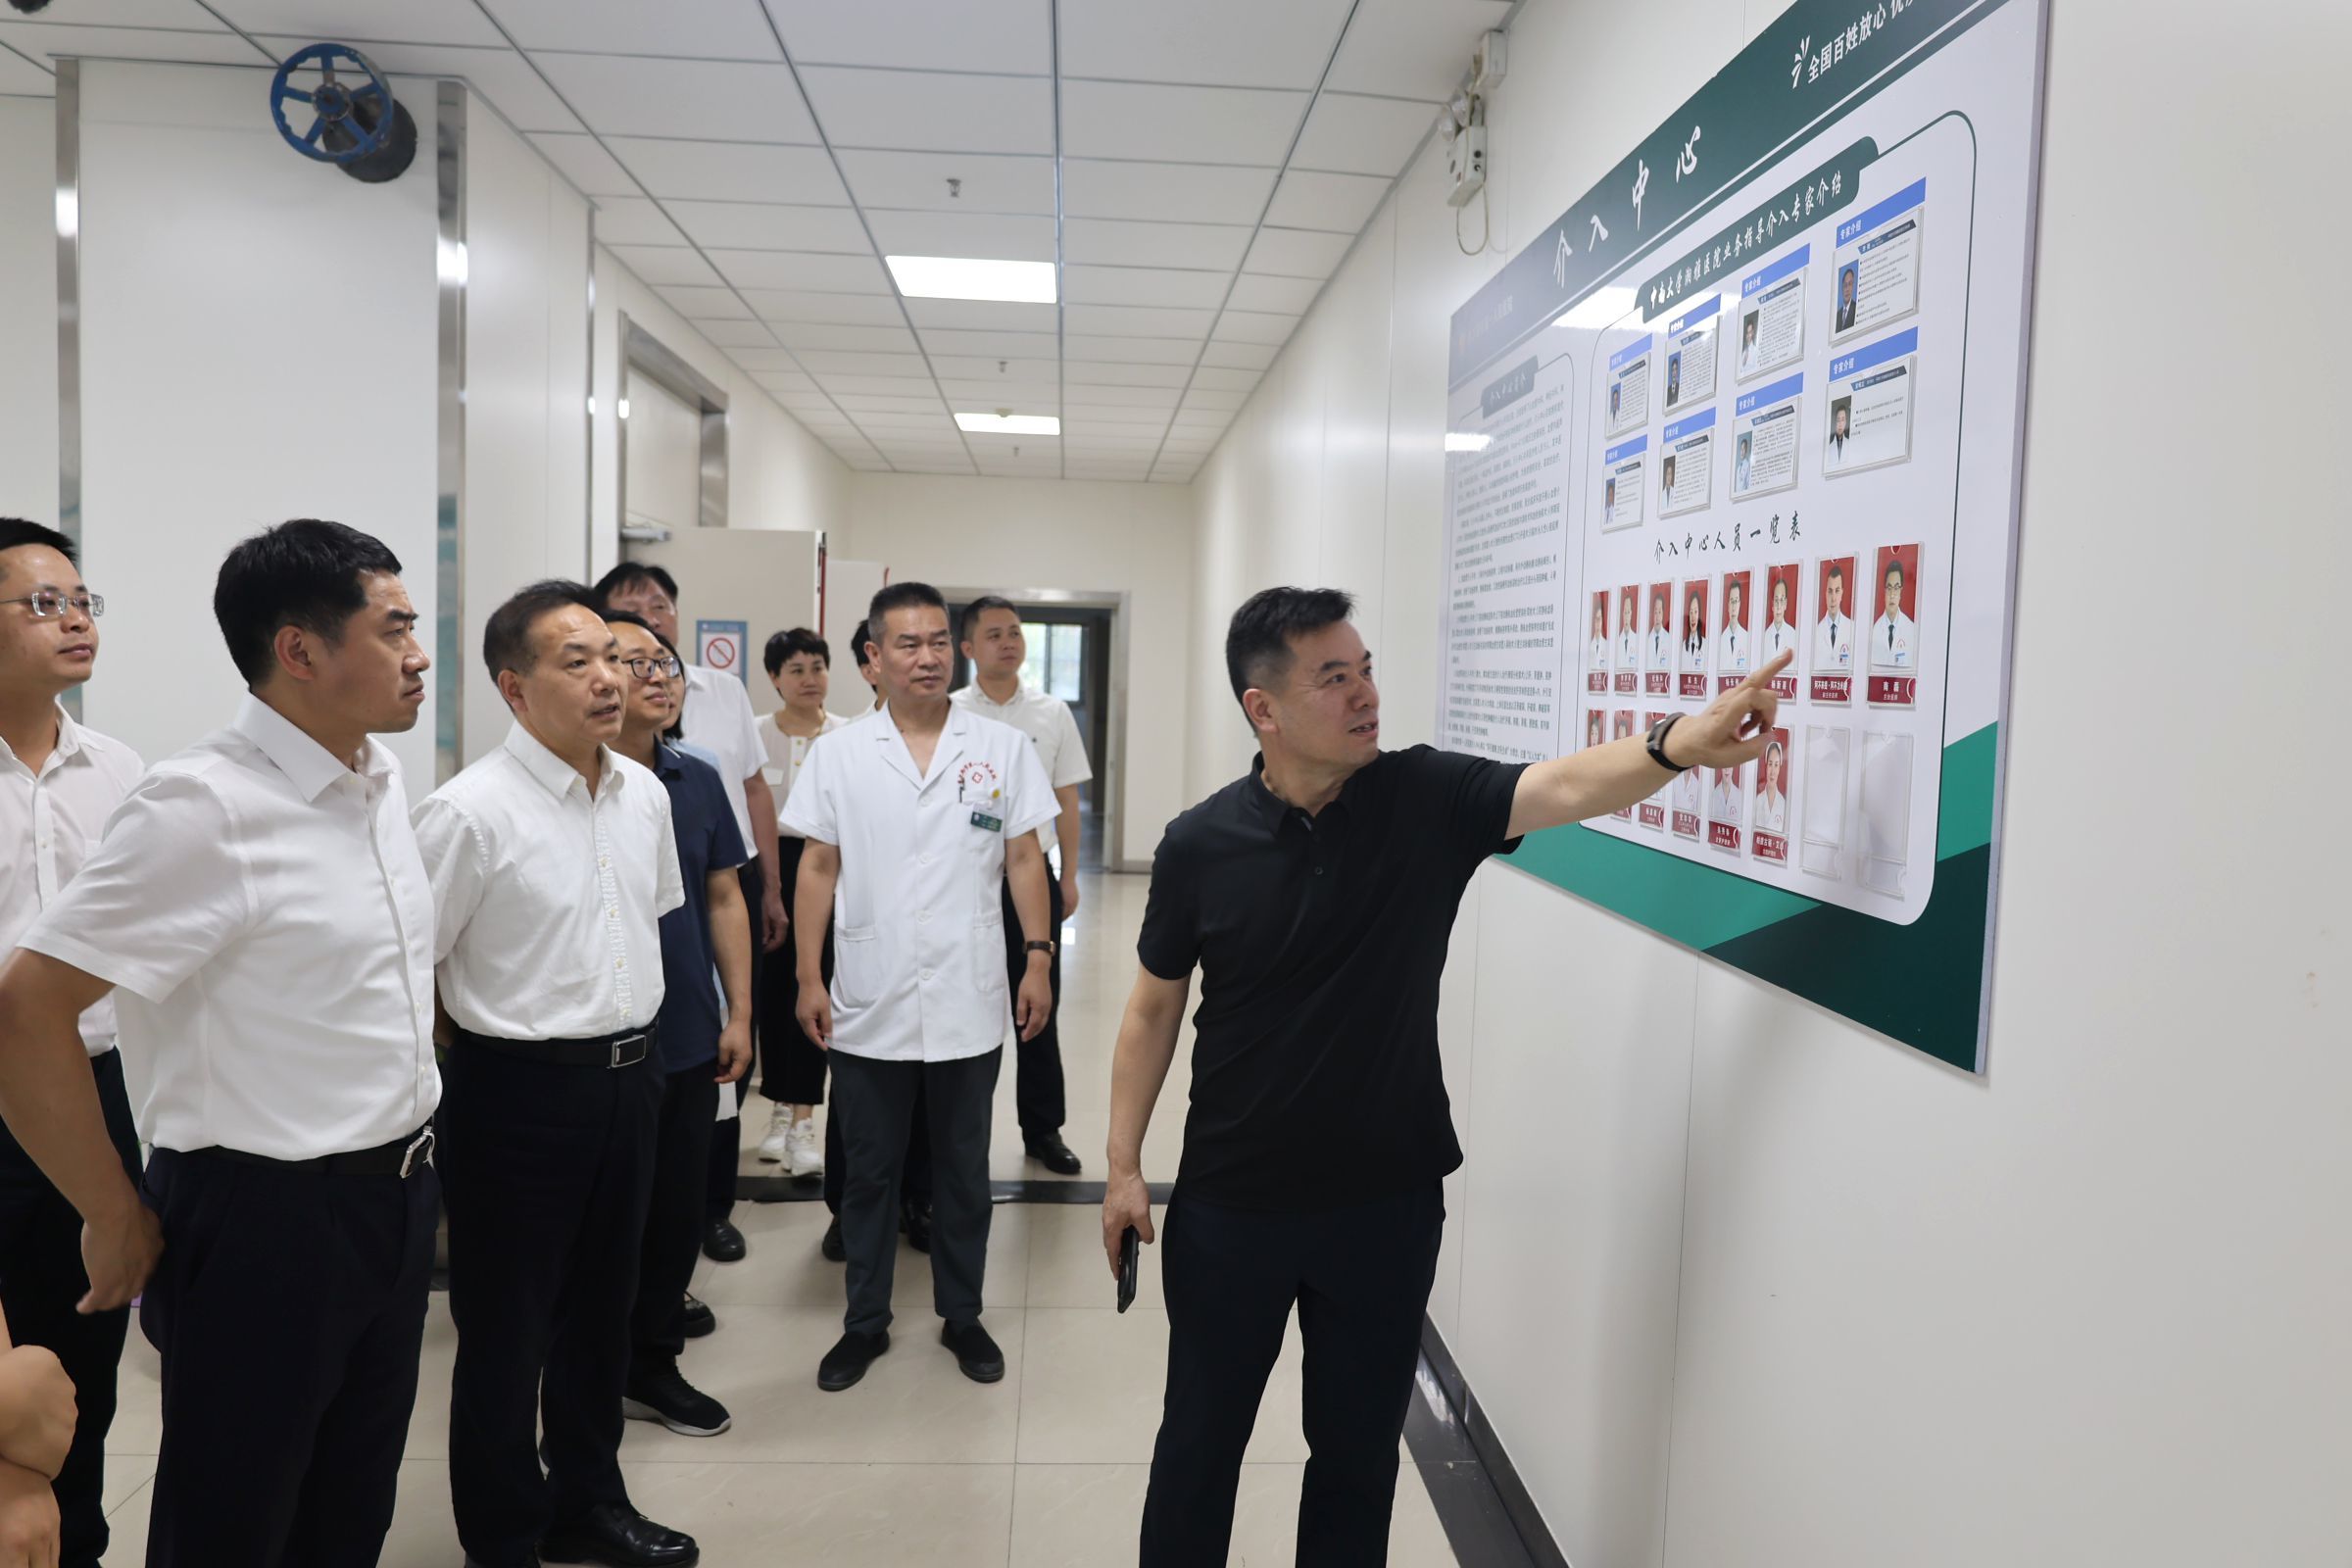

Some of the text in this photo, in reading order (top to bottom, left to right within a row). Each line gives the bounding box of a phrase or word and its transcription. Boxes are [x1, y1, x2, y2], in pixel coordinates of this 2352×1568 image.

[1807, 5, 1886, 84] 全国百姓放心
[1553, 125, 1701, 289] 介入中心
[1839, 220, 1862, 241] 专家介绍
[1650, 171, 1841, 311] 中南大学湘雅医院业务指导介入专家介绍
[1834, 358, 1854, 374] 专家介绍
[1654, 511, 1801, 564] 介入中心人员一览表
